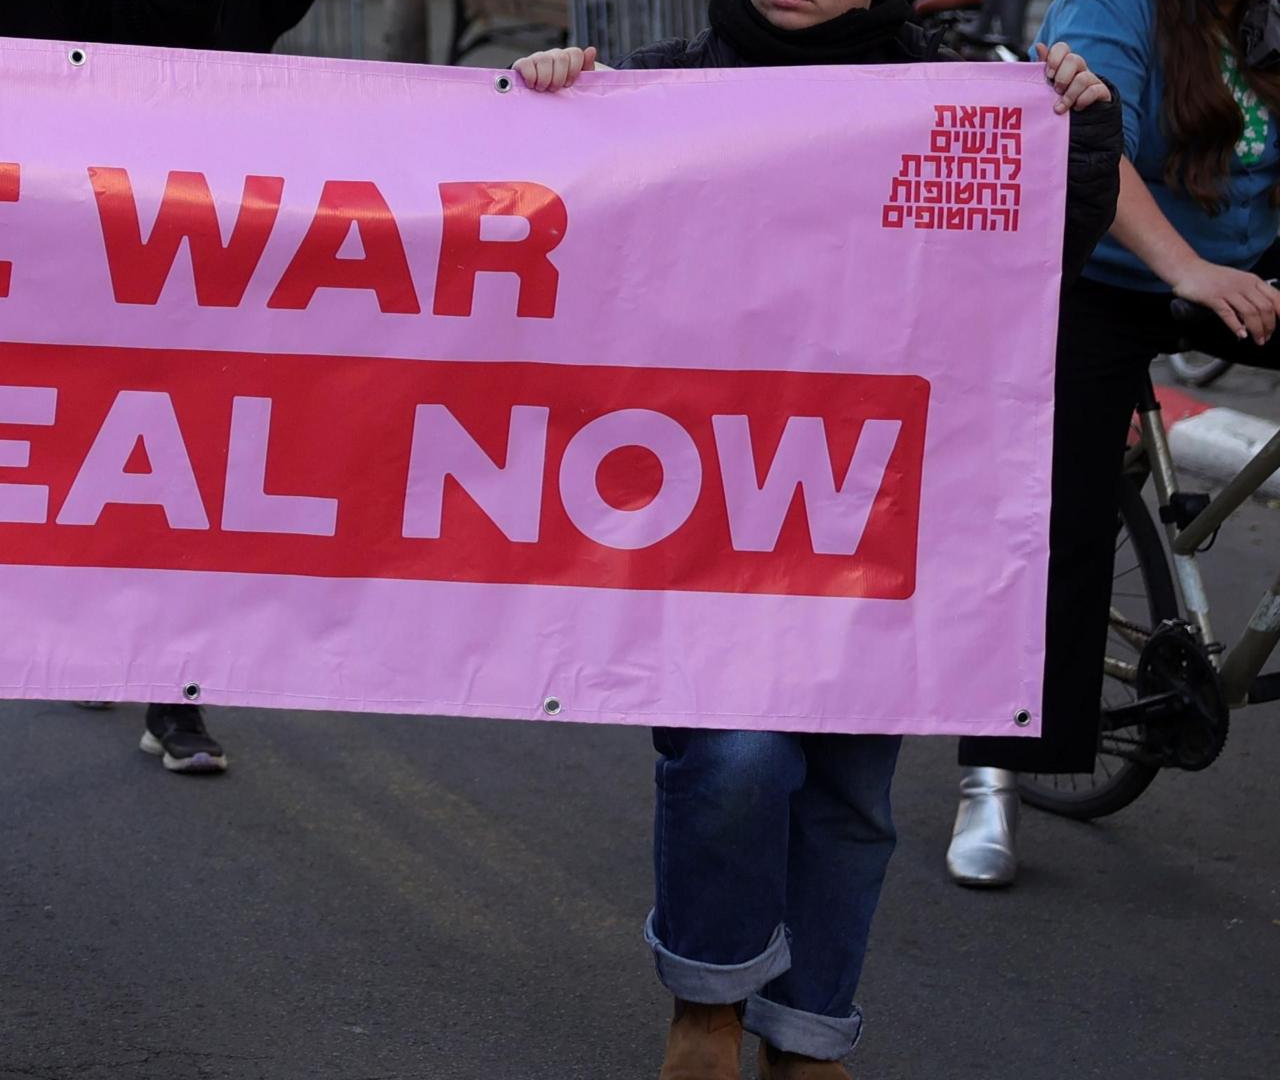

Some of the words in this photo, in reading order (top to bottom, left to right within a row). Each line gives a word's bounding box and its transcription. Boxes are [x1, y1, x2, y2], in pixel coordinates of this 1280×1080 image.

[934, 104, 1022, 131] מחאת
[930, 129, 1022, 156] הנשים
[899, 153, 1022, 181] להחזרת
[889, 176, 1021, 206] החטופות
[881, 204, 1020, 232] והחטופים
[89, 167, 568, 319] WAR
[402, 403, 902, 556] NOW
